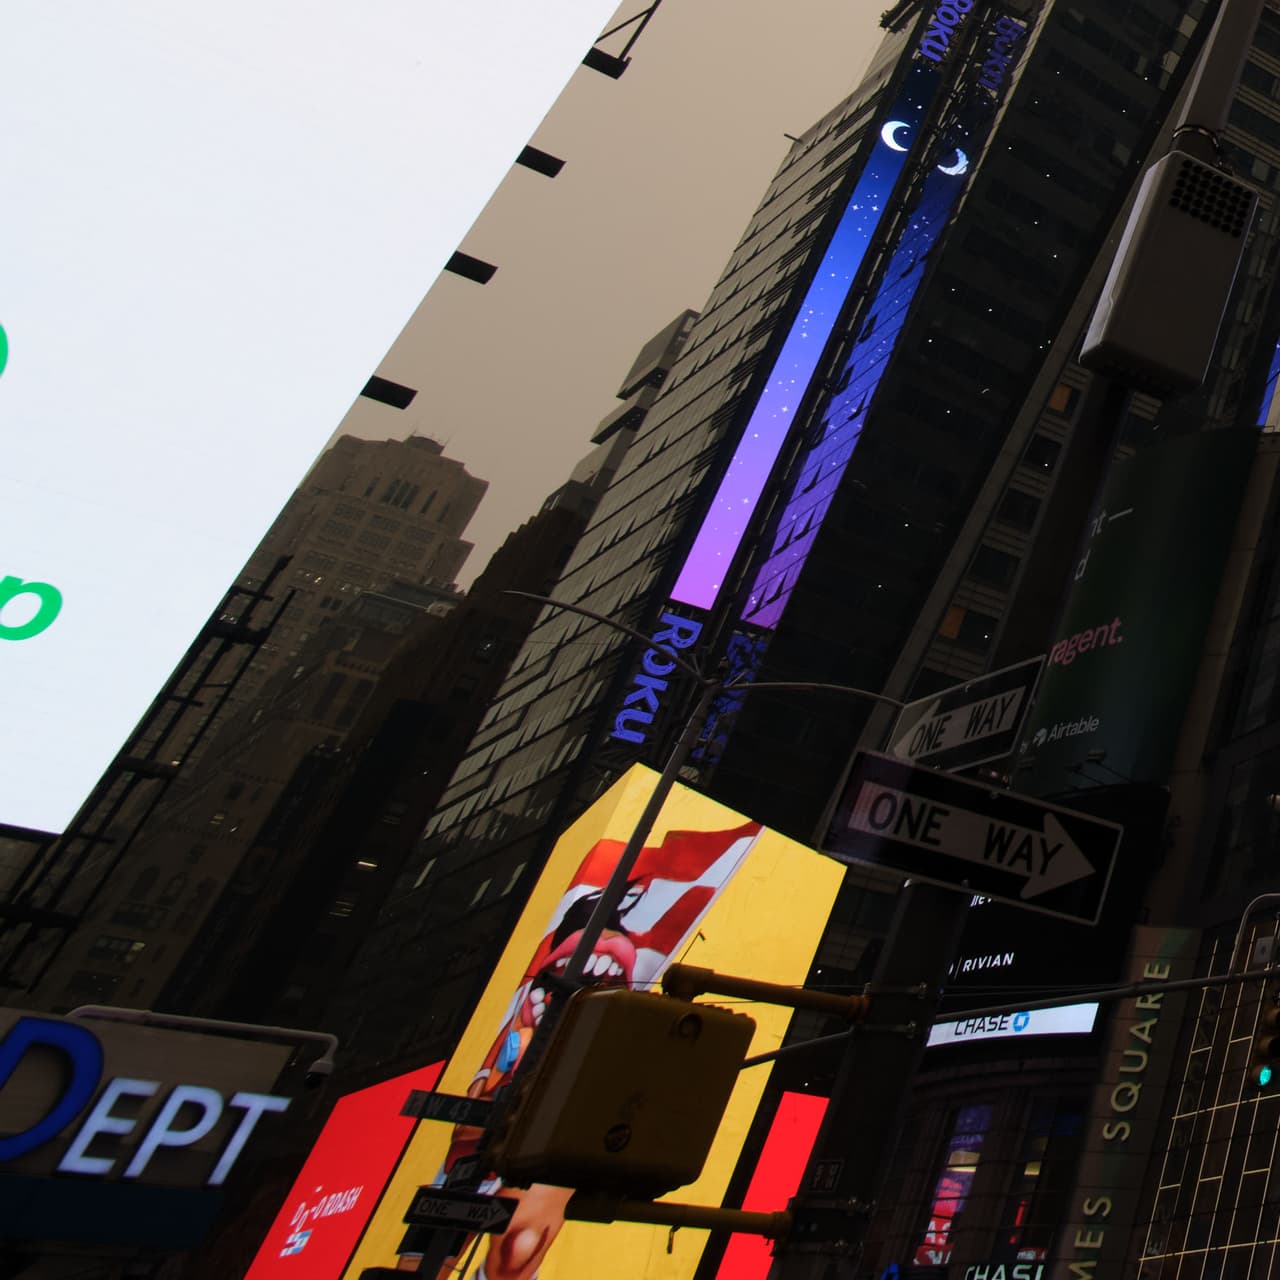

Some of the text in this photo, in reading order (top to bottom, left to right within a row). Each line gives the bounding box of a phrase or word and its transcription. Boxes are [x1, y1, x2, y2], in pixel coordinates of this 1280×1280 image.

[908, 692, 1017, 758] ONE WAY
[1047, 715, 1100, 744] Airtable
[867, 792, 1064, 876] ONE WAY
[962, 951, 1015, 974] RIVIAN
[954, 1013, 1011, 1036] CHASE
[1103, 962, 1171, 1142] SQUARE
[419, 1199, 501, 1220] ONE WAY
